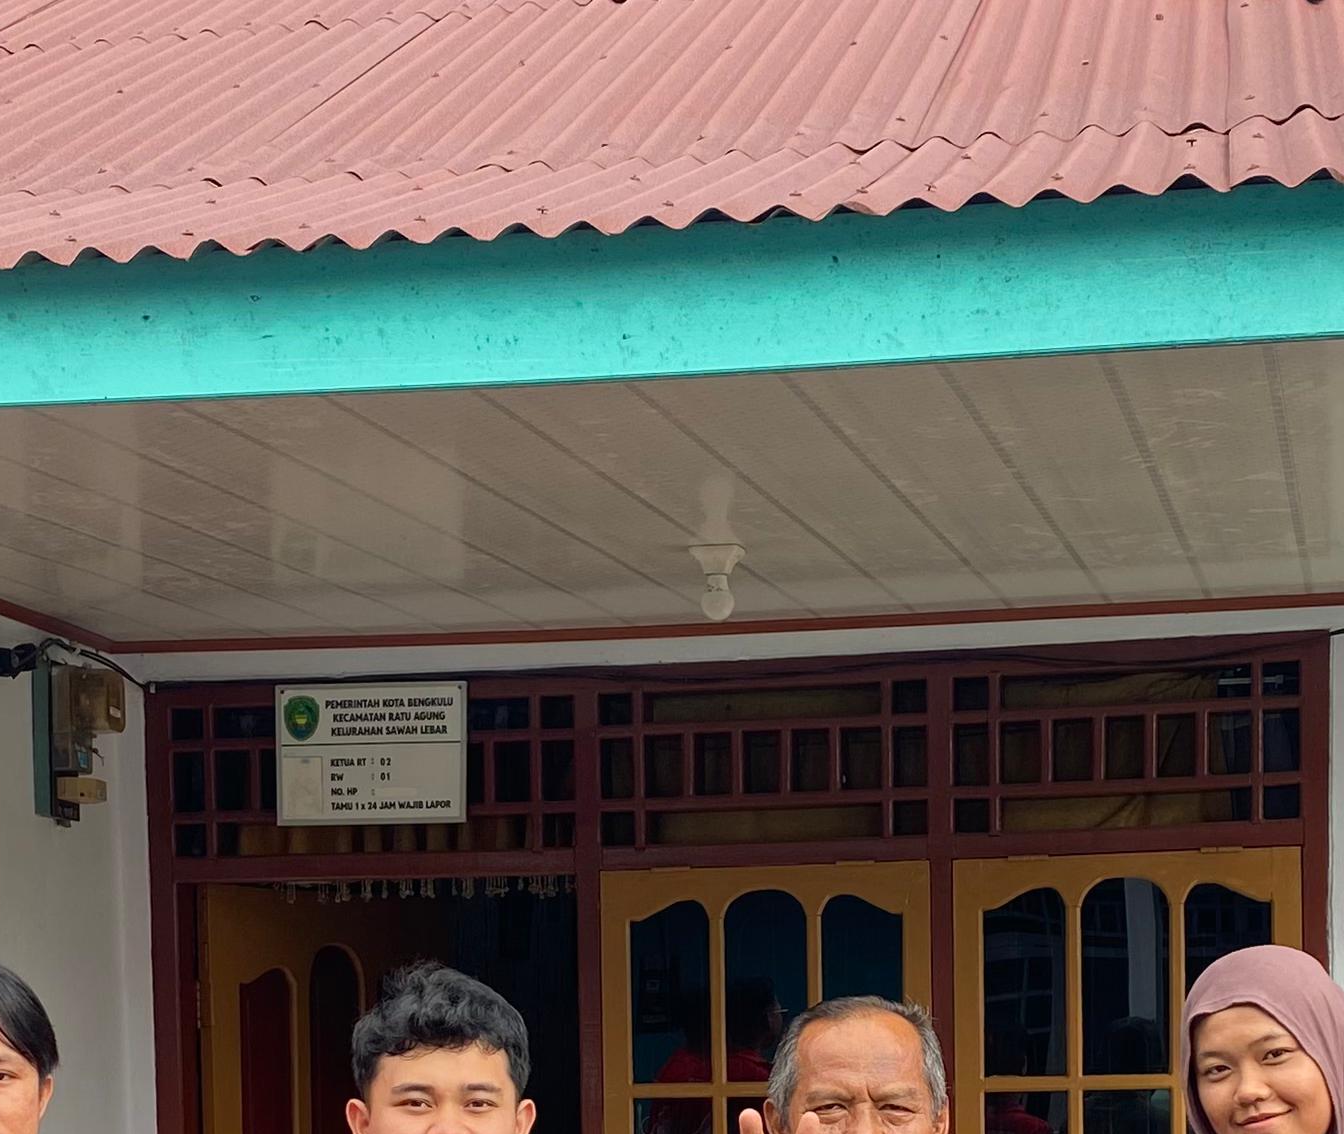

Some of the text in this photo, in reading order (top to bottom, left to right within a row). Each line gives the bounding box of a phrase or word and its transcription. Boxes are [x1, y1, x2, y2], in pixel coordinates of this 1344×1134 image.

[325, 697, 454, 709] PEMERINTAH KOTA BENGKULU
[332, 711, 446, 723] KECAMATAN RATU AGUNG
[331, 724, 448, 736] KELURAHAN SAWAH LEBAR
[330, 758, 355, 767] KETUA
[357, 758, 367, 766] RT
[330, 773, 344, 781] RW
[331, 787, 345, 796] NO.
[346, 787, 358, 796] HP
[331, 802, 353, 811] TAMU
[367, 801, 377, 810] 24
[379, 801, 396, 810] JAM
[398, 800, 424, 809] WAJIB
[425, 800, 451, 809] LAPOR
